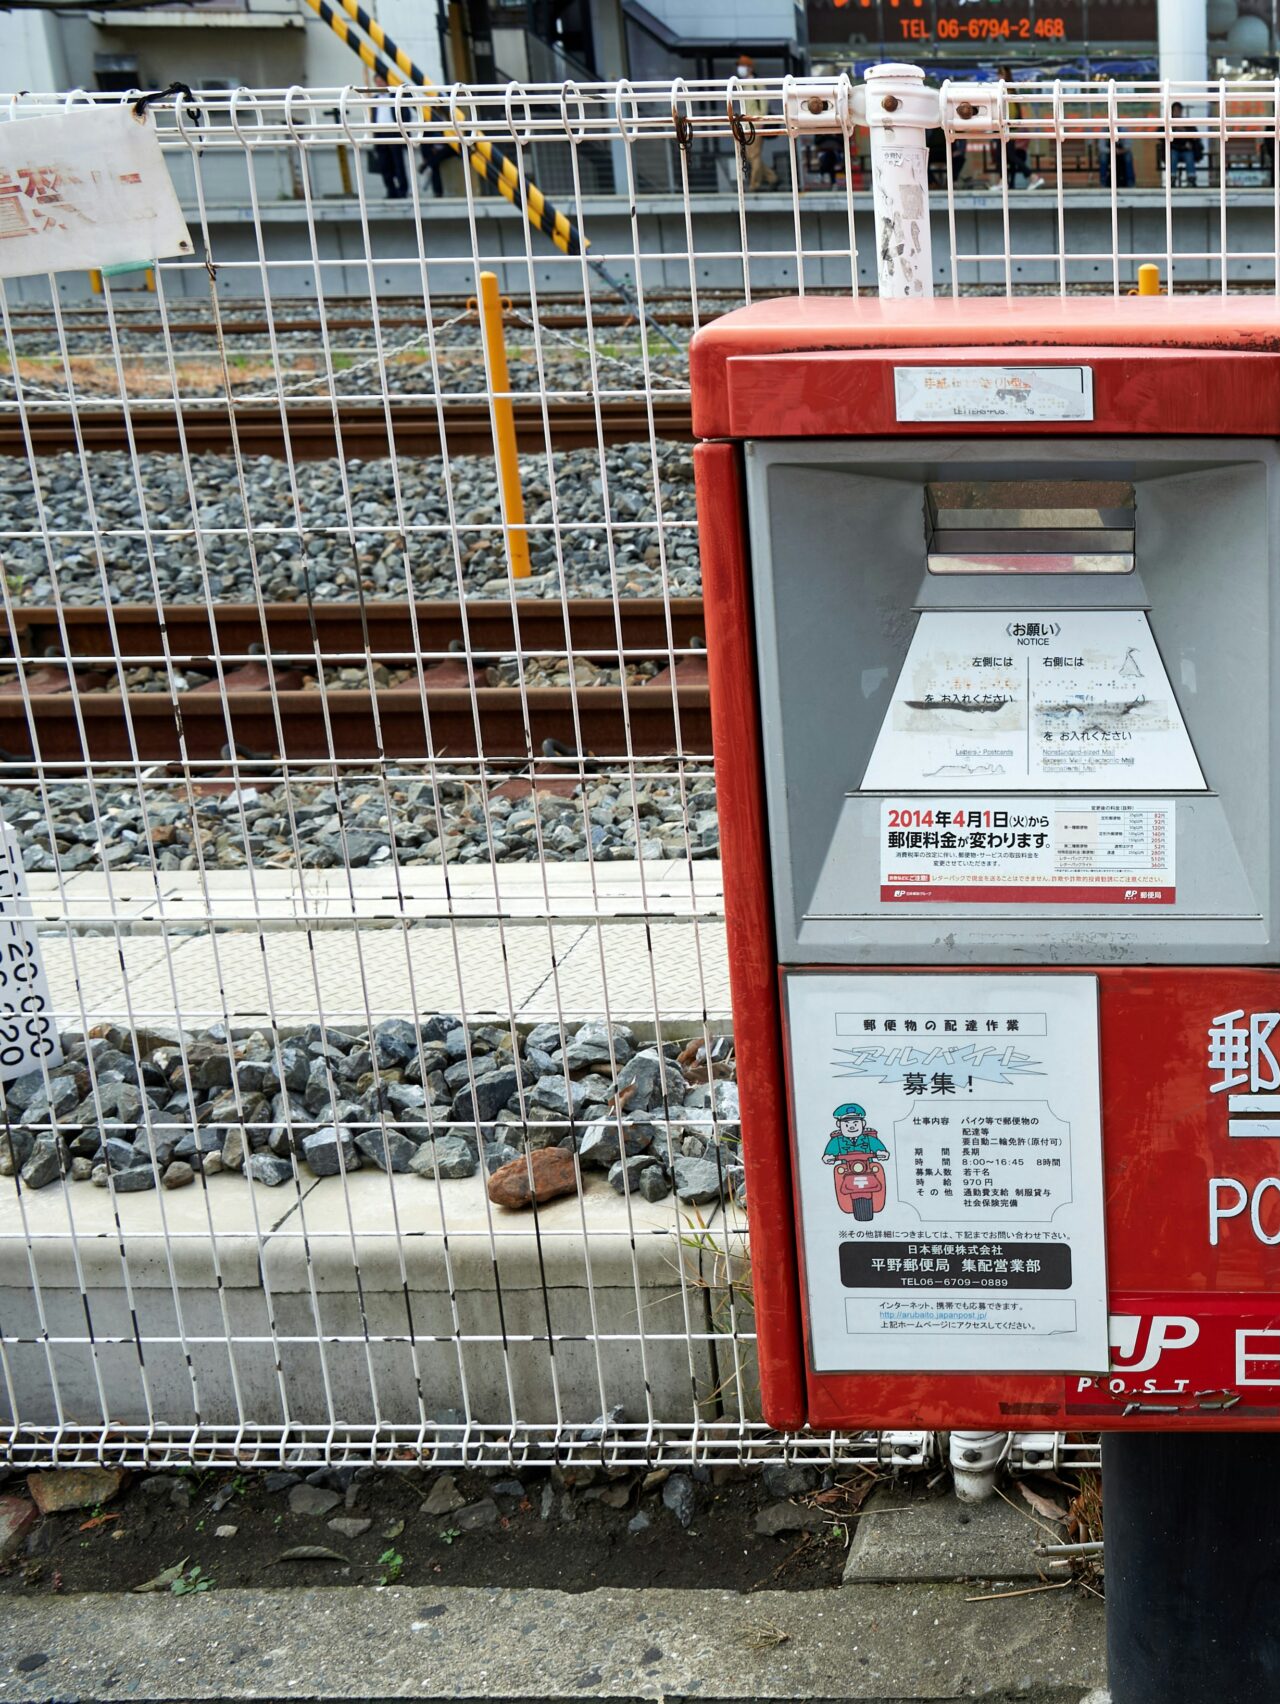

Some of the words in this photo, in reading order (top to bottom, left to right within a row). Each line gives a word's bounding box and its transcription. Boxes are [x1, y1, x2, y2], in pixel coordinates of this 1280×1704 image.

[900, 19, 929, 38] TEL
[1017, 638, 1049, 646] NOTICE
[972, 656, 1013, 667] 左側には
[1042, 656, 1084, 668] 右側には
[1060, 731, 1132, 741] お入れください
[888, 831, 1051, 849] 郵便料金が変わります。
[852, 1045, 1031, 1067] アルバイト
[912, 1116, 950, 1125] 仕事内容
[961, 1116, 1039, 1125] バイク等で郵便物の
[962, 1127, 989, 1136] 配達等
[962, 1148, 980, 1156] 長期
[1036, 1158, 1061, 1167] 8時間
[915, 1168, 952, 1176] 募集人数
[963, 1168, 990, 1176] 若干名
[963, 1188, 1009, 1197] 通勤費支給
[1015, 1188, 1052, 1197] 制服貸与
[963, 1199, 1018, 1207] 社会保険完備
[908, 1245, 1004, 1256] 日本郵便株式会社
[871, 1258, 950, 1273] 平野郵便局
[961, 1258, 1041, 1273] 集配営業部
[879, 1301, 1024, 1311] インターネット、携帯でも応募できます。
[880, 1321, 1036, 1330] 上記ホームページにアクセスしてください。
